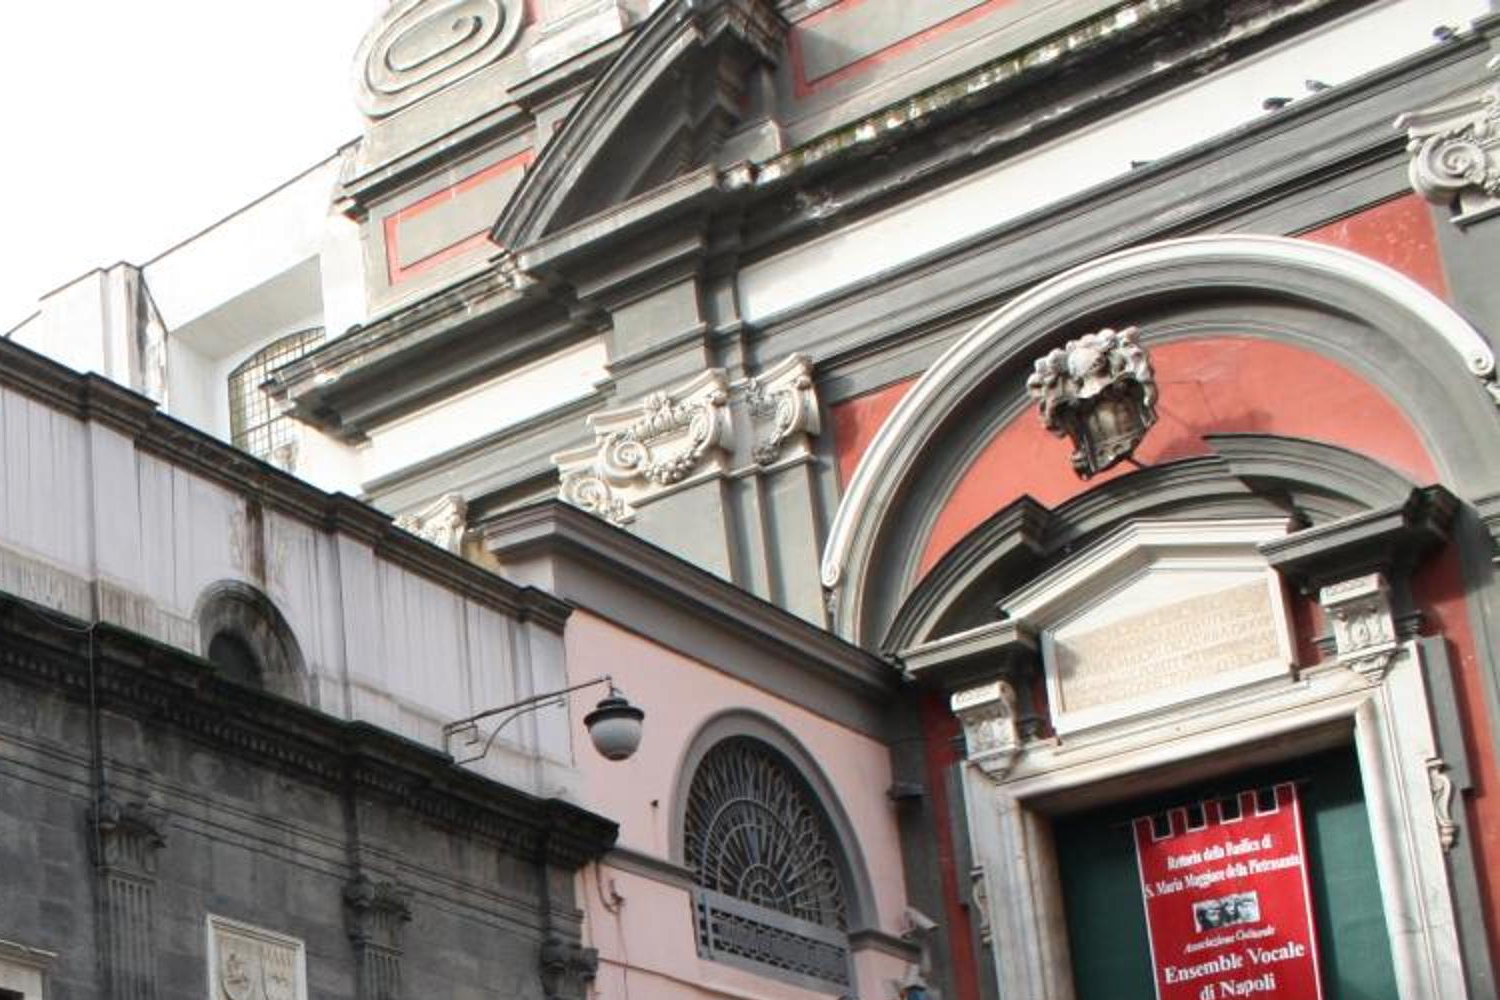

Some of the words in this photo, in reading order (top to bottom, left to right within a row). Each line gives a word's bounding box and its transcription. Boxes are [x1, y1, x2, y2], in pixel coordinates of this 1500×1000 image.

[1203, 845, 1225, 861] della
[1261, 833, 1272, 849] di
[1156, 877, 1183, 895] Maria
[1185, 869, 1225, 888] Maggiore
[1226, 863, 1248, 878] della
[1164, 953, 1243, 984] Ensemble
[1246, 941, 1305, 965] Vocale
[1219, 972, 1276, 998] Napoli
